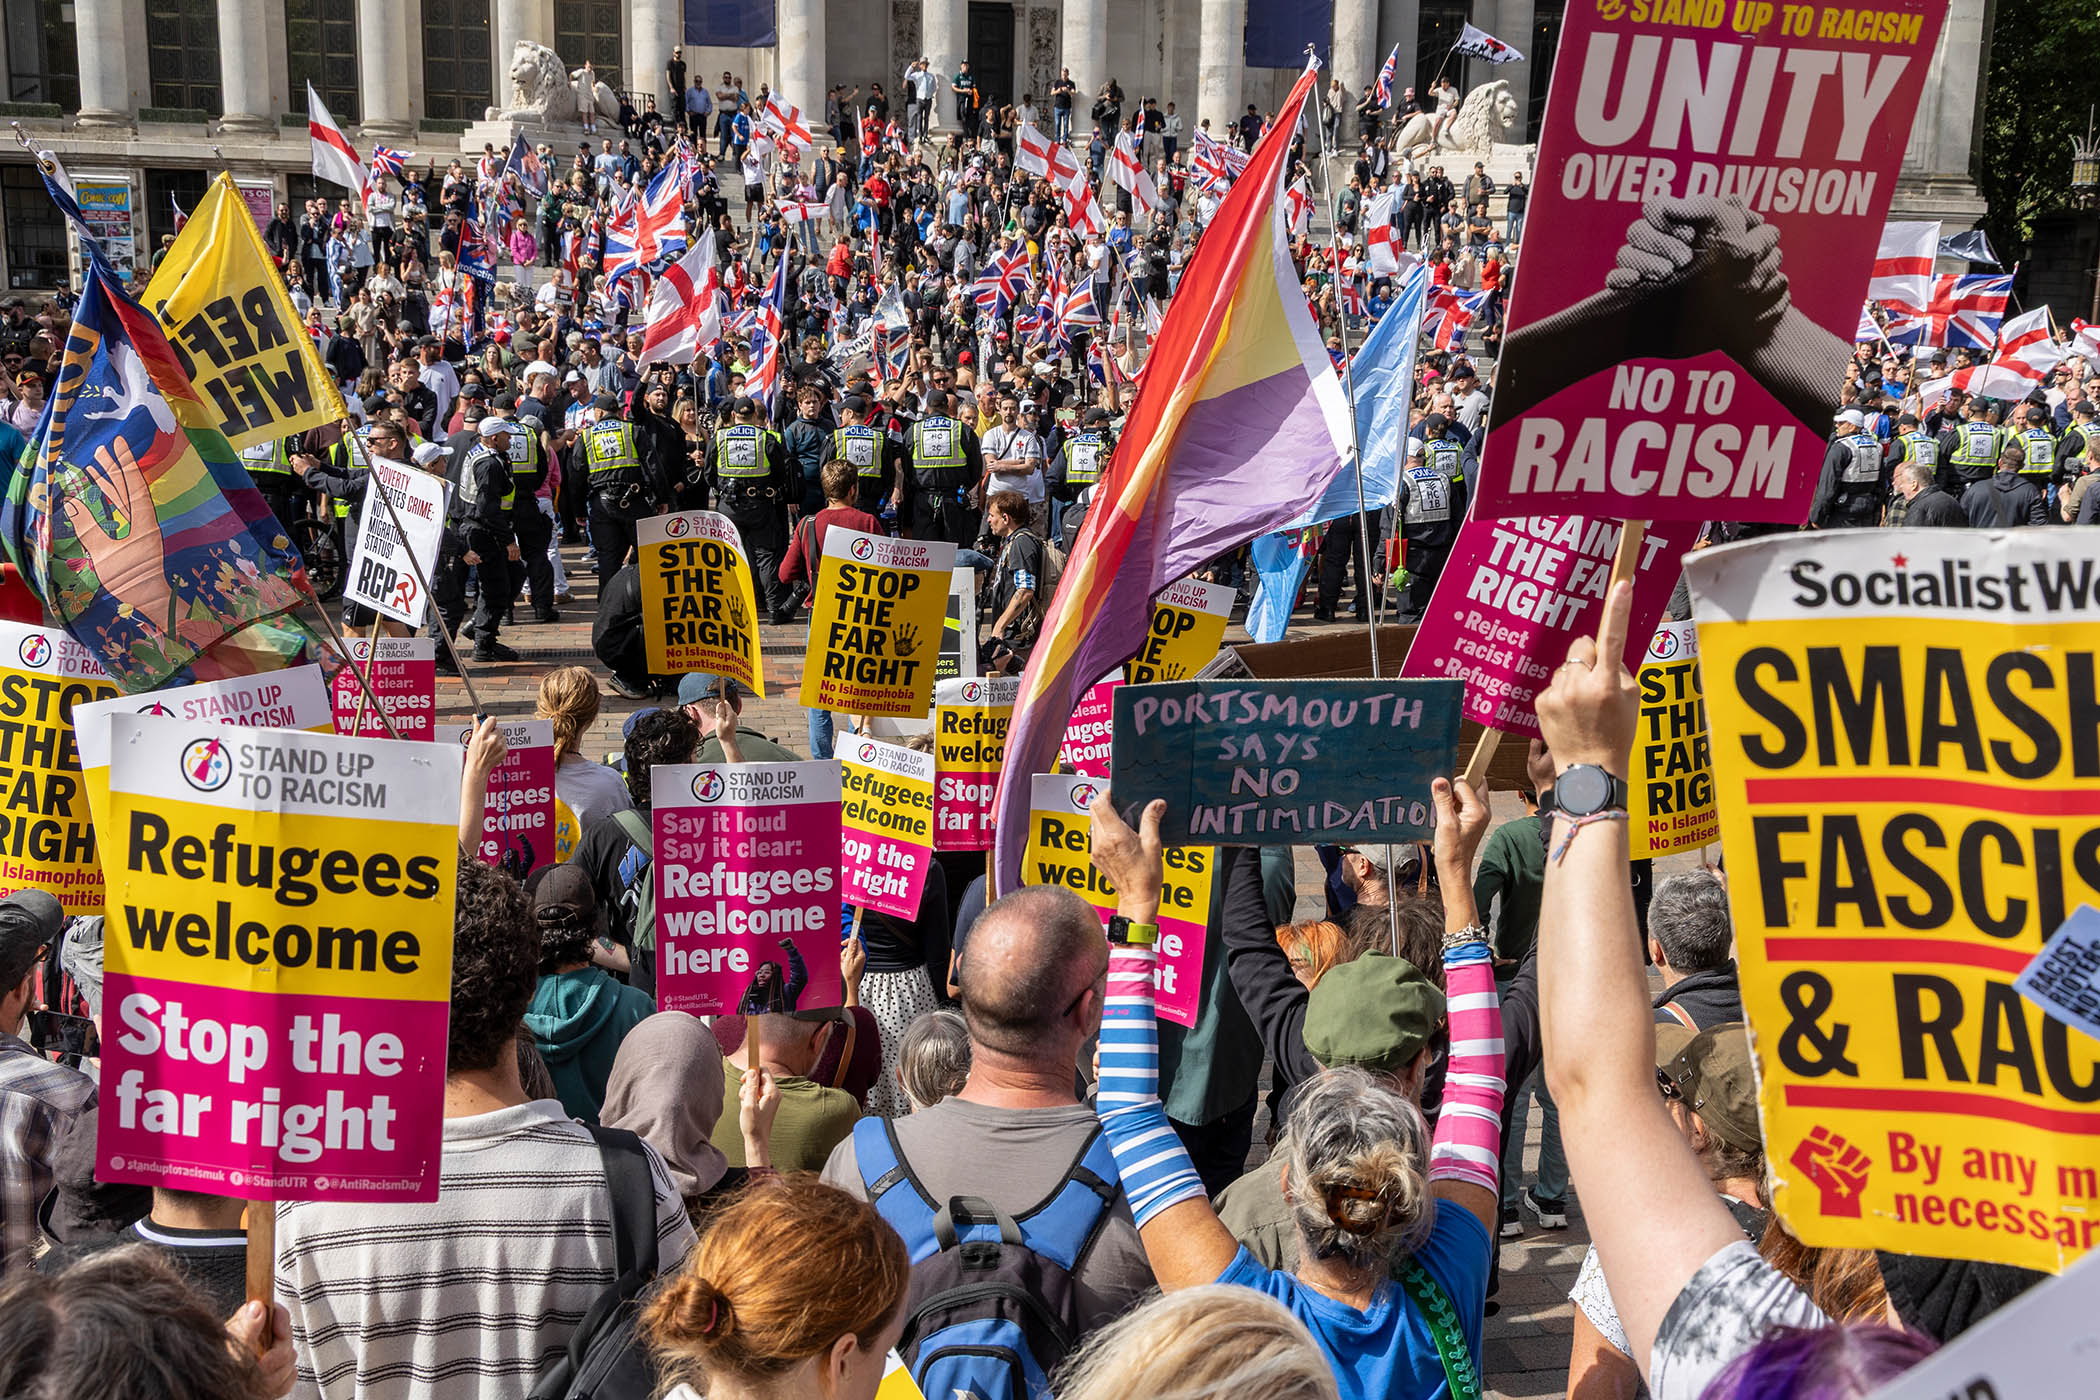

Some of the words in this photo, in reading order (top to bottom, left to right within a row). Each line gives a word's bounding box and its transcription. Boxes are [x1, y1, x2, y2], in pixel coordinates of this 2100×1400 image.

[1631, 0, 1724, 28] STAND
[1732, 0, 1772, 34] UP
[1782, 6, 1814, 37] TO
[1819, 8, 1923, 44] RACISM
[1574, 32, 1910, 162] UNITY
[1562, 153, 1676, 202] OVER
[1687, 161, 1877, 217] DIVISION
[1608, 365, 1675, 413] NO
[1684, 370, 1735, 416] TO
[593, 422, 621, 431] POLICE
[845, 427, 874, 435] POLICE
[924, 418, 951, 427] POLICE
[1509, 418, 1796, 499] RACISM
[379, 465, 411, 491] POVERTY
[371, 499, 387, 519] NOT
[375, 484, 406, 509] CREATES
[1427, 490, 1439, 499] HC
[1429, 500, 1440, 508] 1B
[368, 517, 408, 547] MIGRATION
[693, 516, 725, 530] STAND
[727, 523, 735, 535] UP
[693, 527, 708, 536] TO
[710, 529, 738, 549] RACISM
[365, 534, 395, 560] STATUS!
[659, 541, 737, 571] STOP
[878, 543, 910, 556] STAND
[913, 547, 927, 556] UP
[1497, 515, 1668, 571] AGAINT
[877, 553, 890, 563] TO
[892, 556, 929, 568] RACISM
[1488, 528, 1566, 586] THE
[1566, 558, 1636, 600] FA
[357, 556, 398, 602] RCP
[660, 569, 723, 595] THE
[837, 564, 920, 600] STOP
[1192, 586, 1206, 597] UP
[663, 595, 722, 621] FAR
[835, 593, 895, 628] THE
[1171, 594, 1208, 609] RACISM
[1466, 565, 1588, 631] RIGHT
[1153, 608, 1195, 638] OP
[1466, 610, 1530, 649] Reject
[665, 623, 750, 658] RIGHT
[828, 622, 886, 656] FAR
[57, 656, 77, 673] TO
[378, 663, 405, 675] loud
[667, 648, 681, 658] No
[685, 647, 753, 673] Islamophobia
[667, 660, 683, 670] No
[686, 661, 753, 684] antisemitism
[824, 651, 920, 686] RIGHT
[1454, 635, 1513, 670] racist
[1514, 655, 1549, 679] lies
[378, 678, 414, 688] clear:
[821, 680, 836, 692] No
[839, 681, 914, 700] Islamophobia
[984, 682, 1008, 692] STAND
[1009, 682, 1018, 691] UP
[1444, 657, 1532, 702] Refugees
[183, 690, 253, 720] STAND
[260, 685, 282, 707] UP
[819, 694, 834, 705] No
[837, 697, 911, 712] antisemitism
[984, 693, 995, 702] TO
[1133, 689, 1423, 736] PORTSMOUTH
[1471, 688, 1492, 715] to
[1496, 702, 1541, 728] blam
[0, 720, 82, 771] THE
[515, 728, 526, 736] UP
[239, 744, 327, 773] STAND
[337, 752, 374, 778] UP
[878, 748, 908, 761] STAND
[910, 755, 922, 765] UP
[1218, 733, 1320, 764] SAYS
[490, 770, 531, 783] clear:
[730, 773, 775, 785] STAND
[778, 771, 796, 784] UP
[878, 758, 888, 767] TO
[890, 761, 925, 776] RACISM
[238, 772, 272, 800] TO
[281, 777, 387, 808] RACISM
[730, 787, 748, 800] TO
[752, 785, 804, 799] RACISM
[842, 766, 932, 811] Refugees
[939, 778, 993, 807] Stop
[1231, 767, 1300, 798] NO
[662, 813, 705, 838] Say
[713, 812, 730, 833] it
[737, 811, 786, 832] loud
[938, 806, 973, 830] far
[1649, 820, 1668, 834] No
[127, 809, 440, 907] Refugees
[663, 838, 705, 863] Say
[713, 837, 730, 858] it
[736, 838, 802, 857] clear:
[878, 843, 915, 871] the
[1650, 836, 1670, 850] No
[3, 861, 104, 888] Islamophob
[663, 862, 833, 905] Refugees
[852, 866, 908, 898] right
[664, 901, 825, 937] welcome
[124, 900, 420, 974] welcome
[665, 942, 749, 976] here
[117, 993, 268, 1084] Stop
[289, 1013, 404, 1077] the
[1778, 971, 1859, 1077] &
[116, 1069, 212, 1138] far
[230, 1087, 396, 1163] right
[127, 1159, 226, 1182] standuptoracismuk
[243, 1174, 308, 1189] @StandUTR
[329, 1178, 422, 1192] @AntiRacismDay
[1888, 1131, 1942, 1185] By
[1963, 1147, 2037, 1196] any
[1895, 1192, 2100, 1249] necessar
